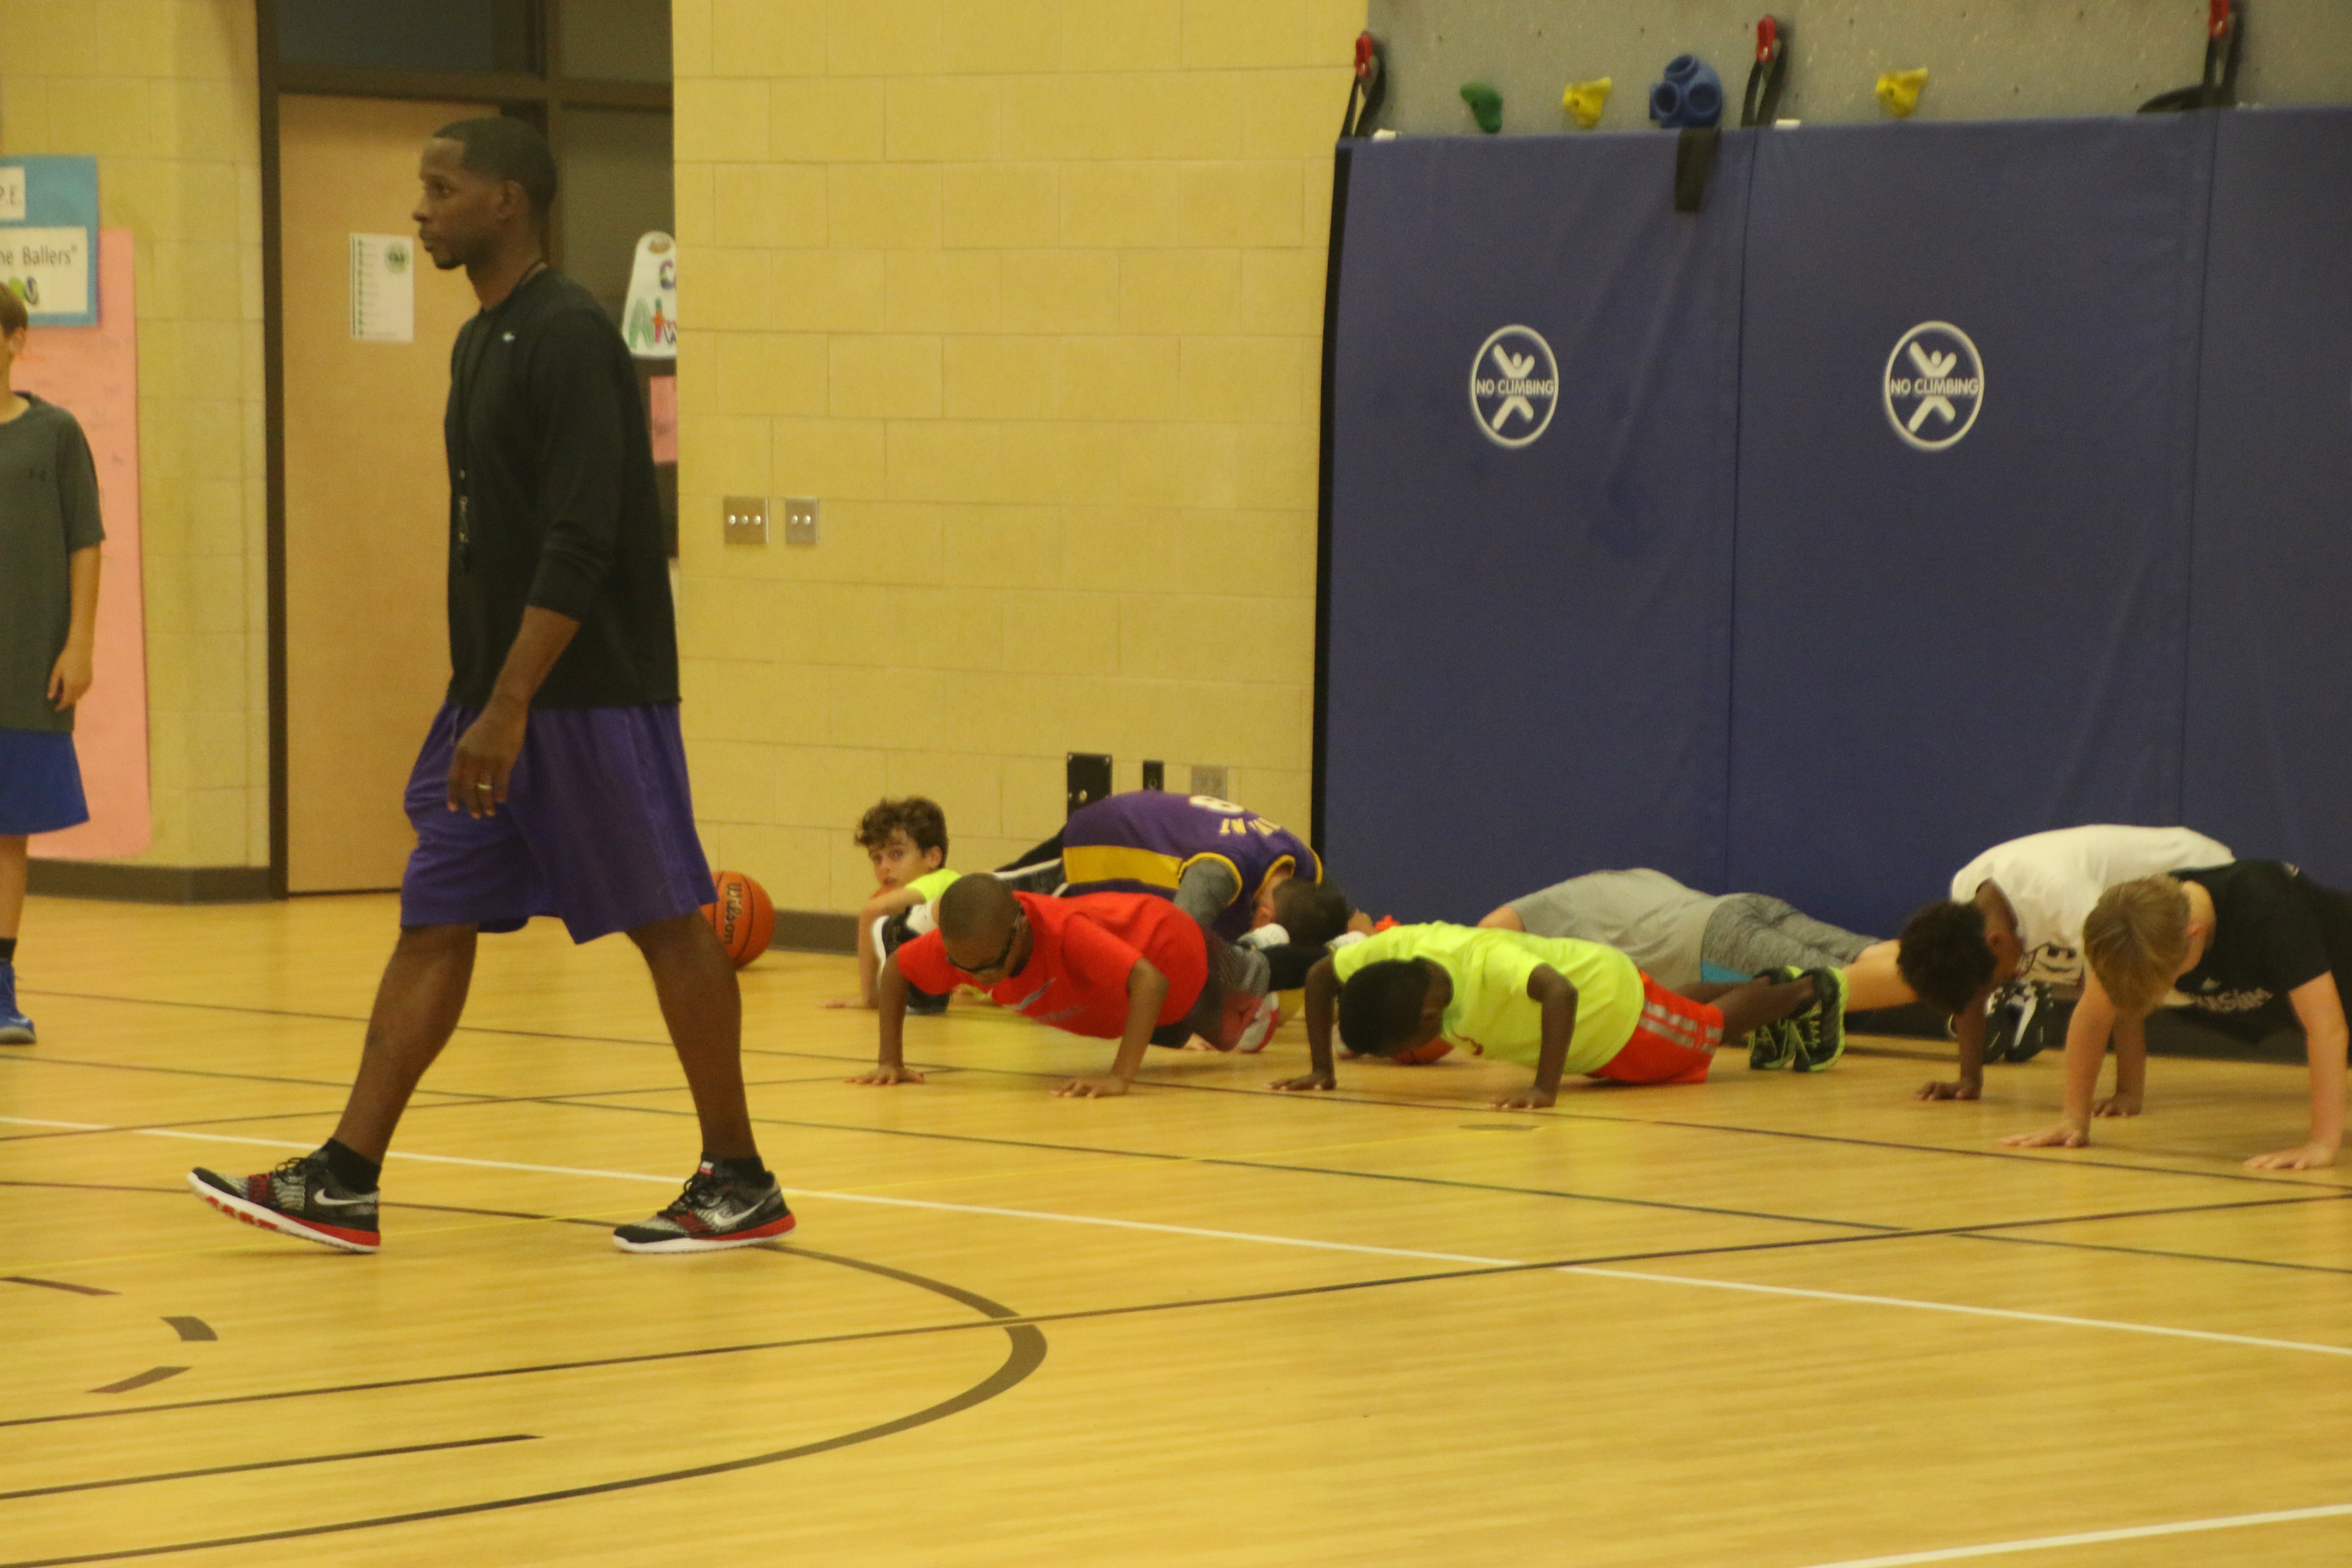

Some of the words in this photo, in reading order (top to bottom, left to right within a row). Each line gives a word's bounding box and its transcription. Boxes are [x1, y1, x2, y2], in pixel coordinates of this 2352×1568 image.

[1476, 379, 1495, 395] NO
[1498, 378, 1554, 395] CLIMBING
[1891, 378, 1911, 395] NO
[1914, 378, 1979, 395] CLIMBING
